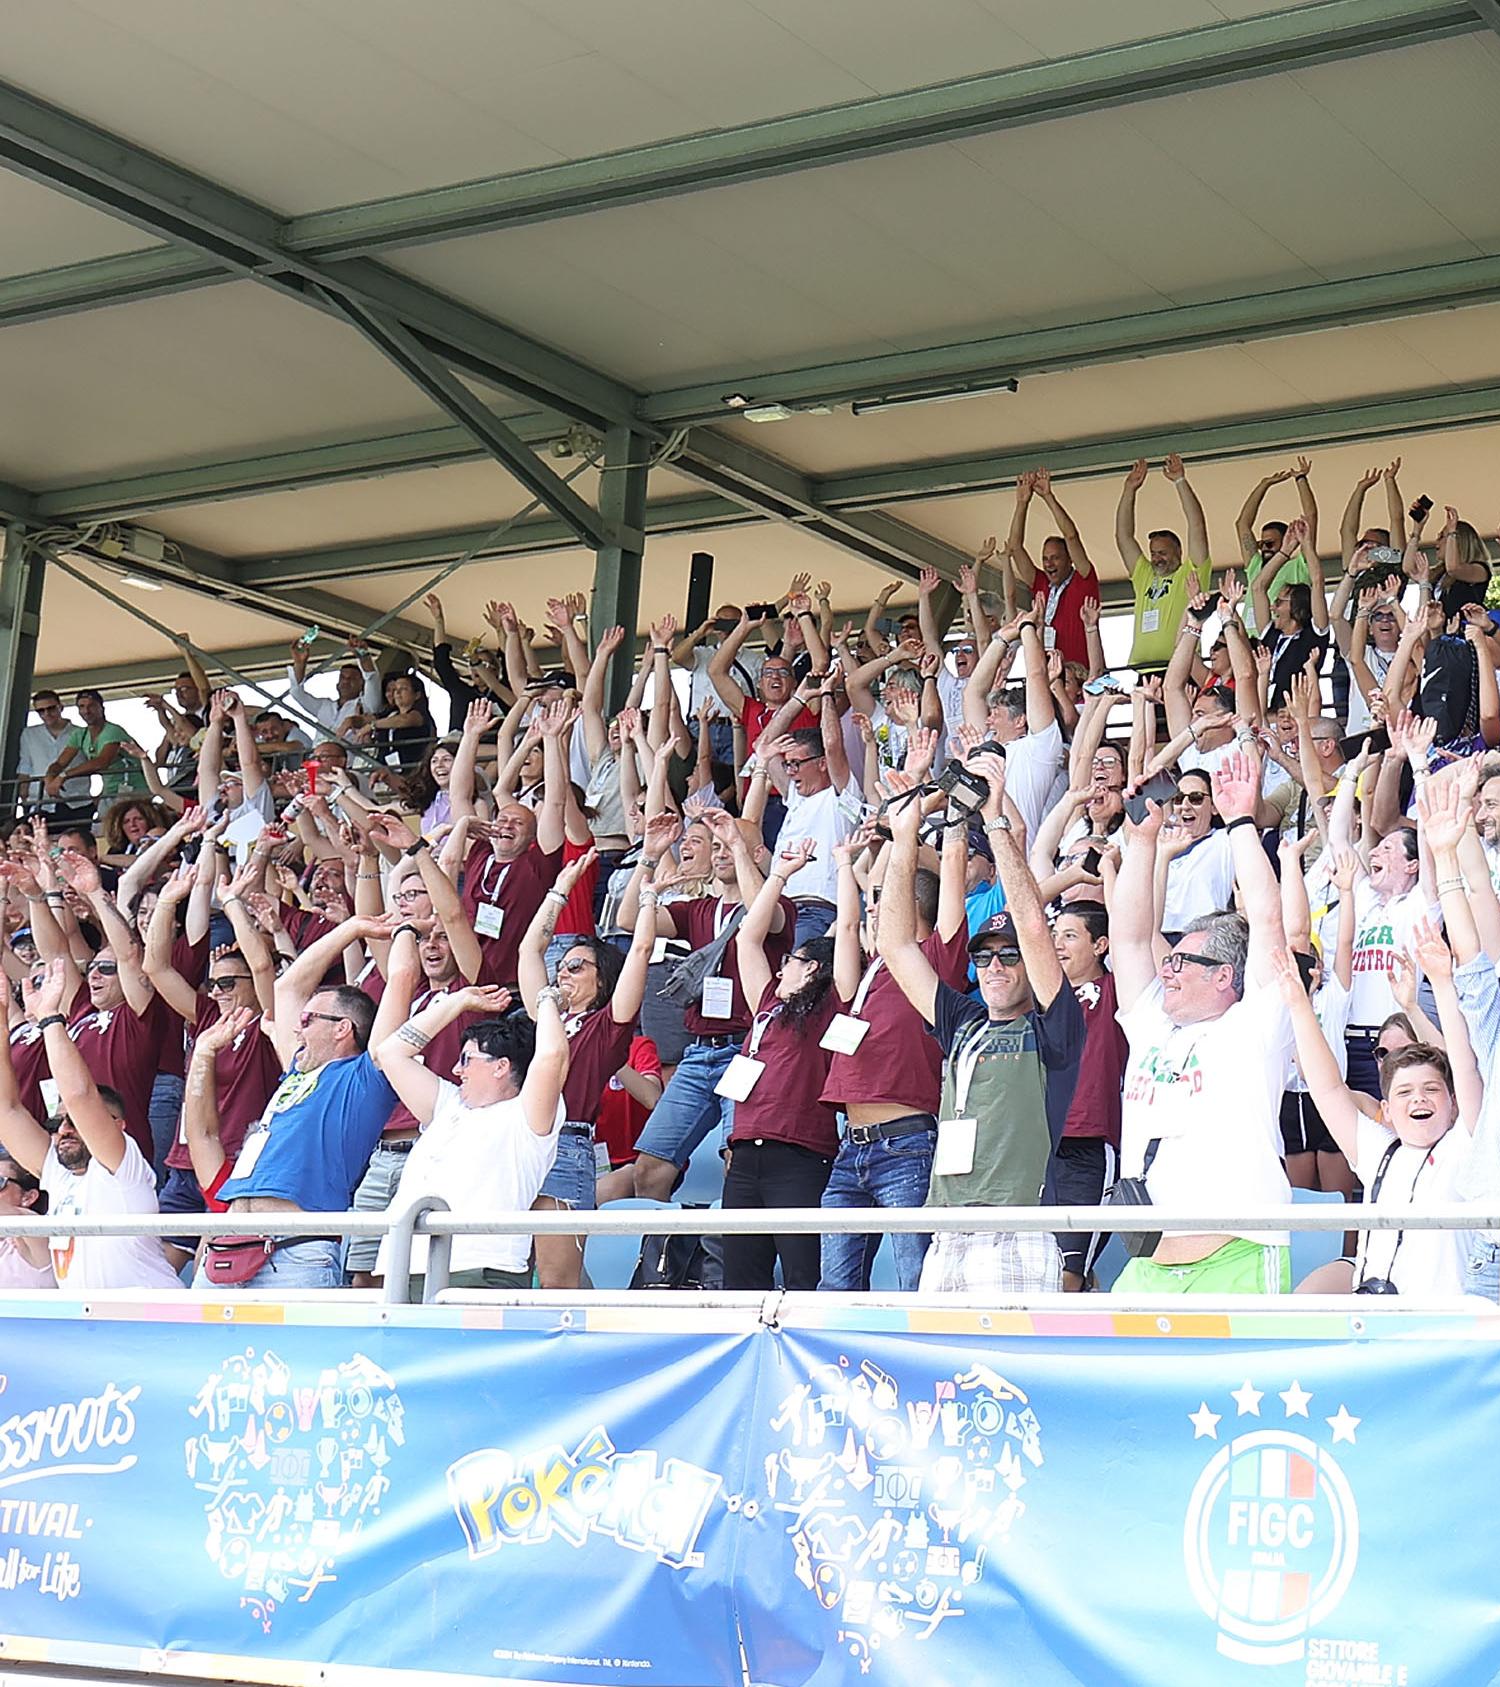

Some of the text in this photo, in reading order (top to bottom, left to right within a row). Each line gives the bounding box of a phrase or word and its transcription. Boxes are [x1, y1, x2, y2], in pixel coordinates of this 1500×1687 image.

[1227, 1502, 1315, 1549] FIGC
[39, 1552, 81, 1602] Life
[1308, 1638, 1380, 1662] SETTORE
[1306, 1659, 1393, 1686] GIOVANILE
